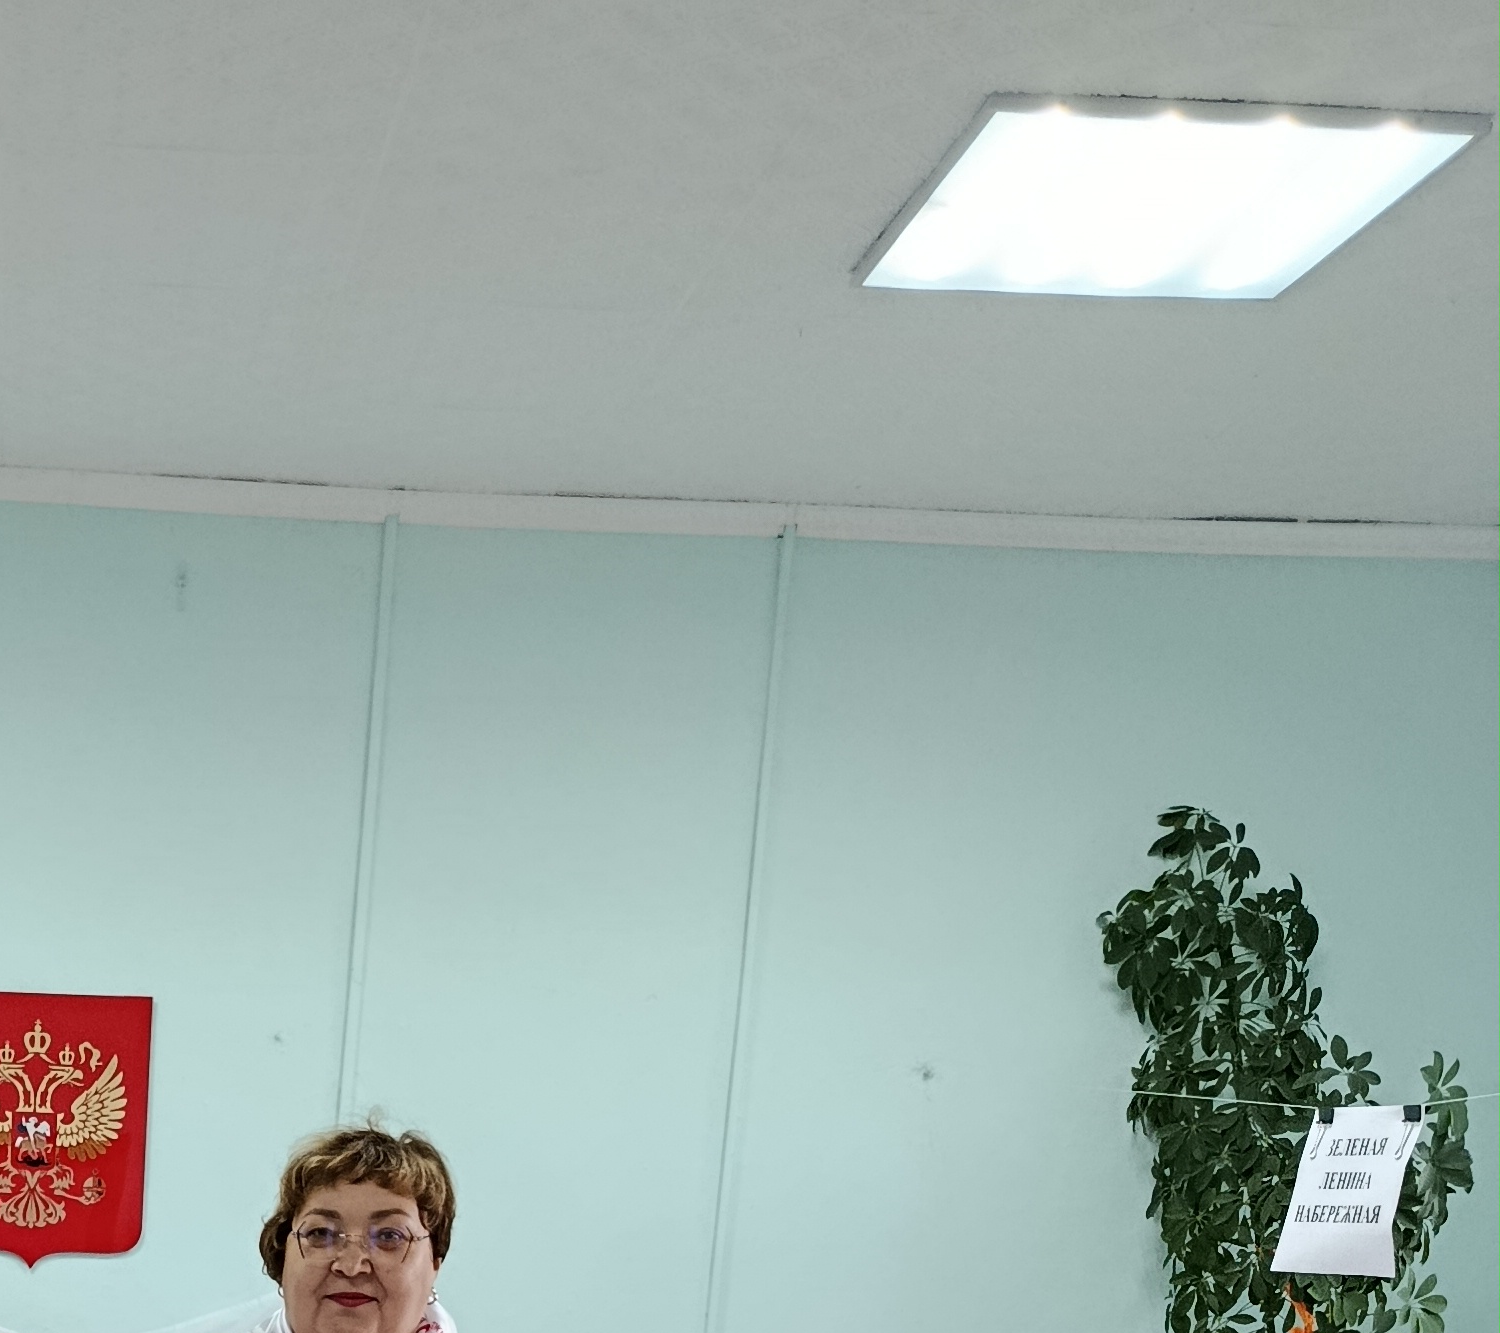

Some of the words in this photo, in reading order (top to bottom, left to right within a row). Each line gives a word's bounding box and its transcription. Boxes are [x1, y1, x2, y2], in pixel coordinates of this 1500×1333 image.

[1327, 1138, 1388, 1156] ЗЕЛЕНАЯ
[1318, 1172, 1372, 1190] ЛЕНИНА
[1294, 1205, 1381, 1223] НАБЕРЕЖНАЯ
